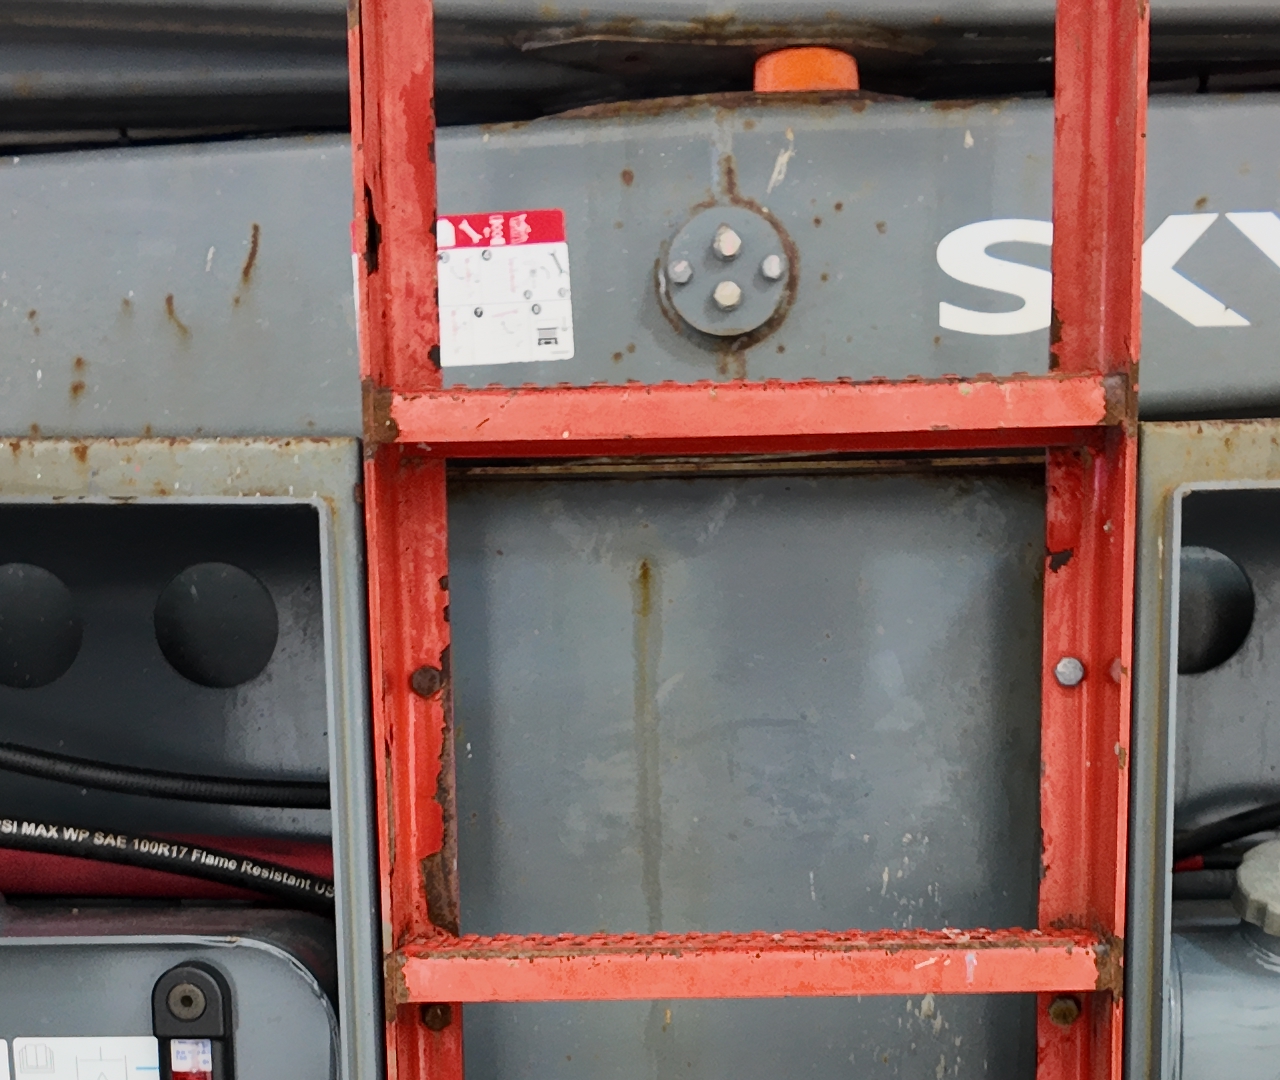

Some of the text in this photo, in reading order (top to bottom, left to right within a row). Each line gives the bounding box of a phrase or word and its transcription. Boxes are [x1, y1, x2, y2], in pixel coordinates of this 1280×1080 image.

[21, 821, 59, 839] MAX
[62, 827, 90, 843] WP
[93, 831, 127, 849] SAE
[133, 838, 189, 859] 100R17
[191, 848, 238, 871] Flame
[240, 860, 312, 890] Resistant
